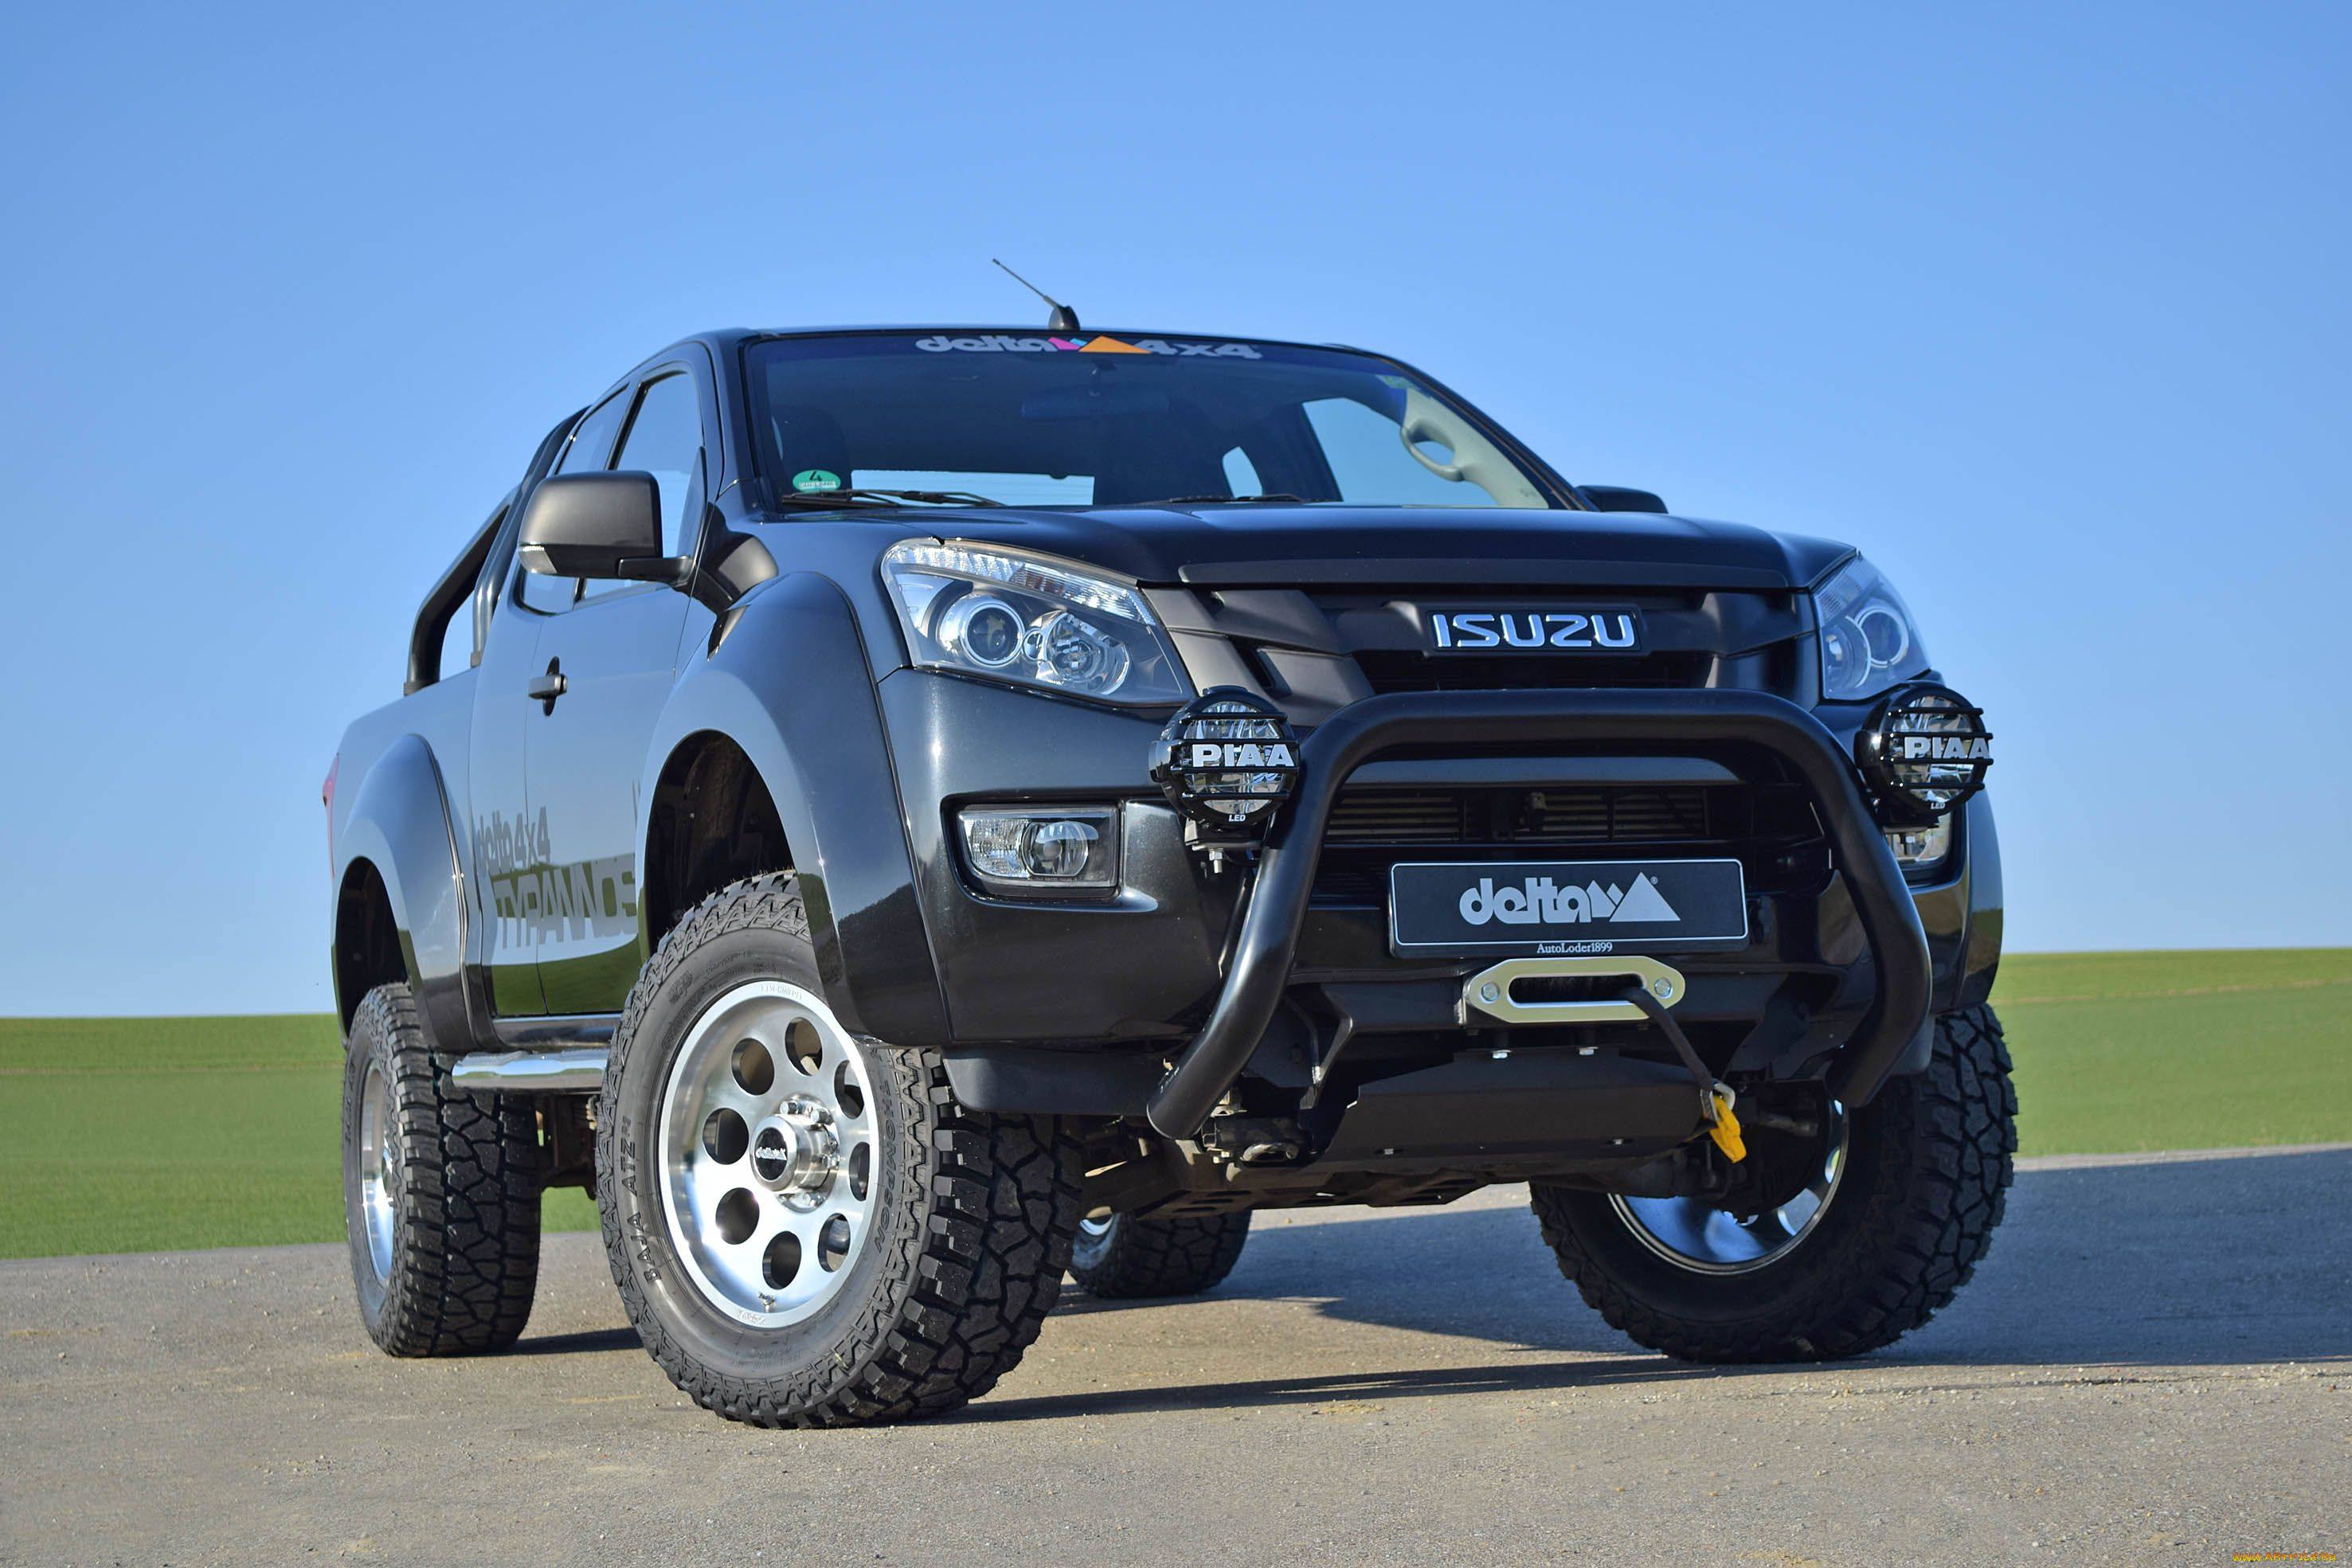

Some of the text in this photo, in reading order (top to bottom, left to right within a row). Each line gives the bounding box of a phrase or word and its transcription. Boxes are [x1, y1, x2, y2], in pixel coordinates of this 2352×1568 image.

[915, 334, 1262, 359] delta 4x4
[1433, 614, 1634, 647] ISUZU
[1192, 743, 1295, 768] PIAA
[1904, 736, 1990, 760] PIAA
[1228, 813, 1246, 822] LED
[1459, 876, 1592, 925] delta
[1536, 941, 1614, 954] AutoLoder1899
[874, 1079, 897, 1253] THOMPSON
[627, 1211, 662, 1284] BAJA
